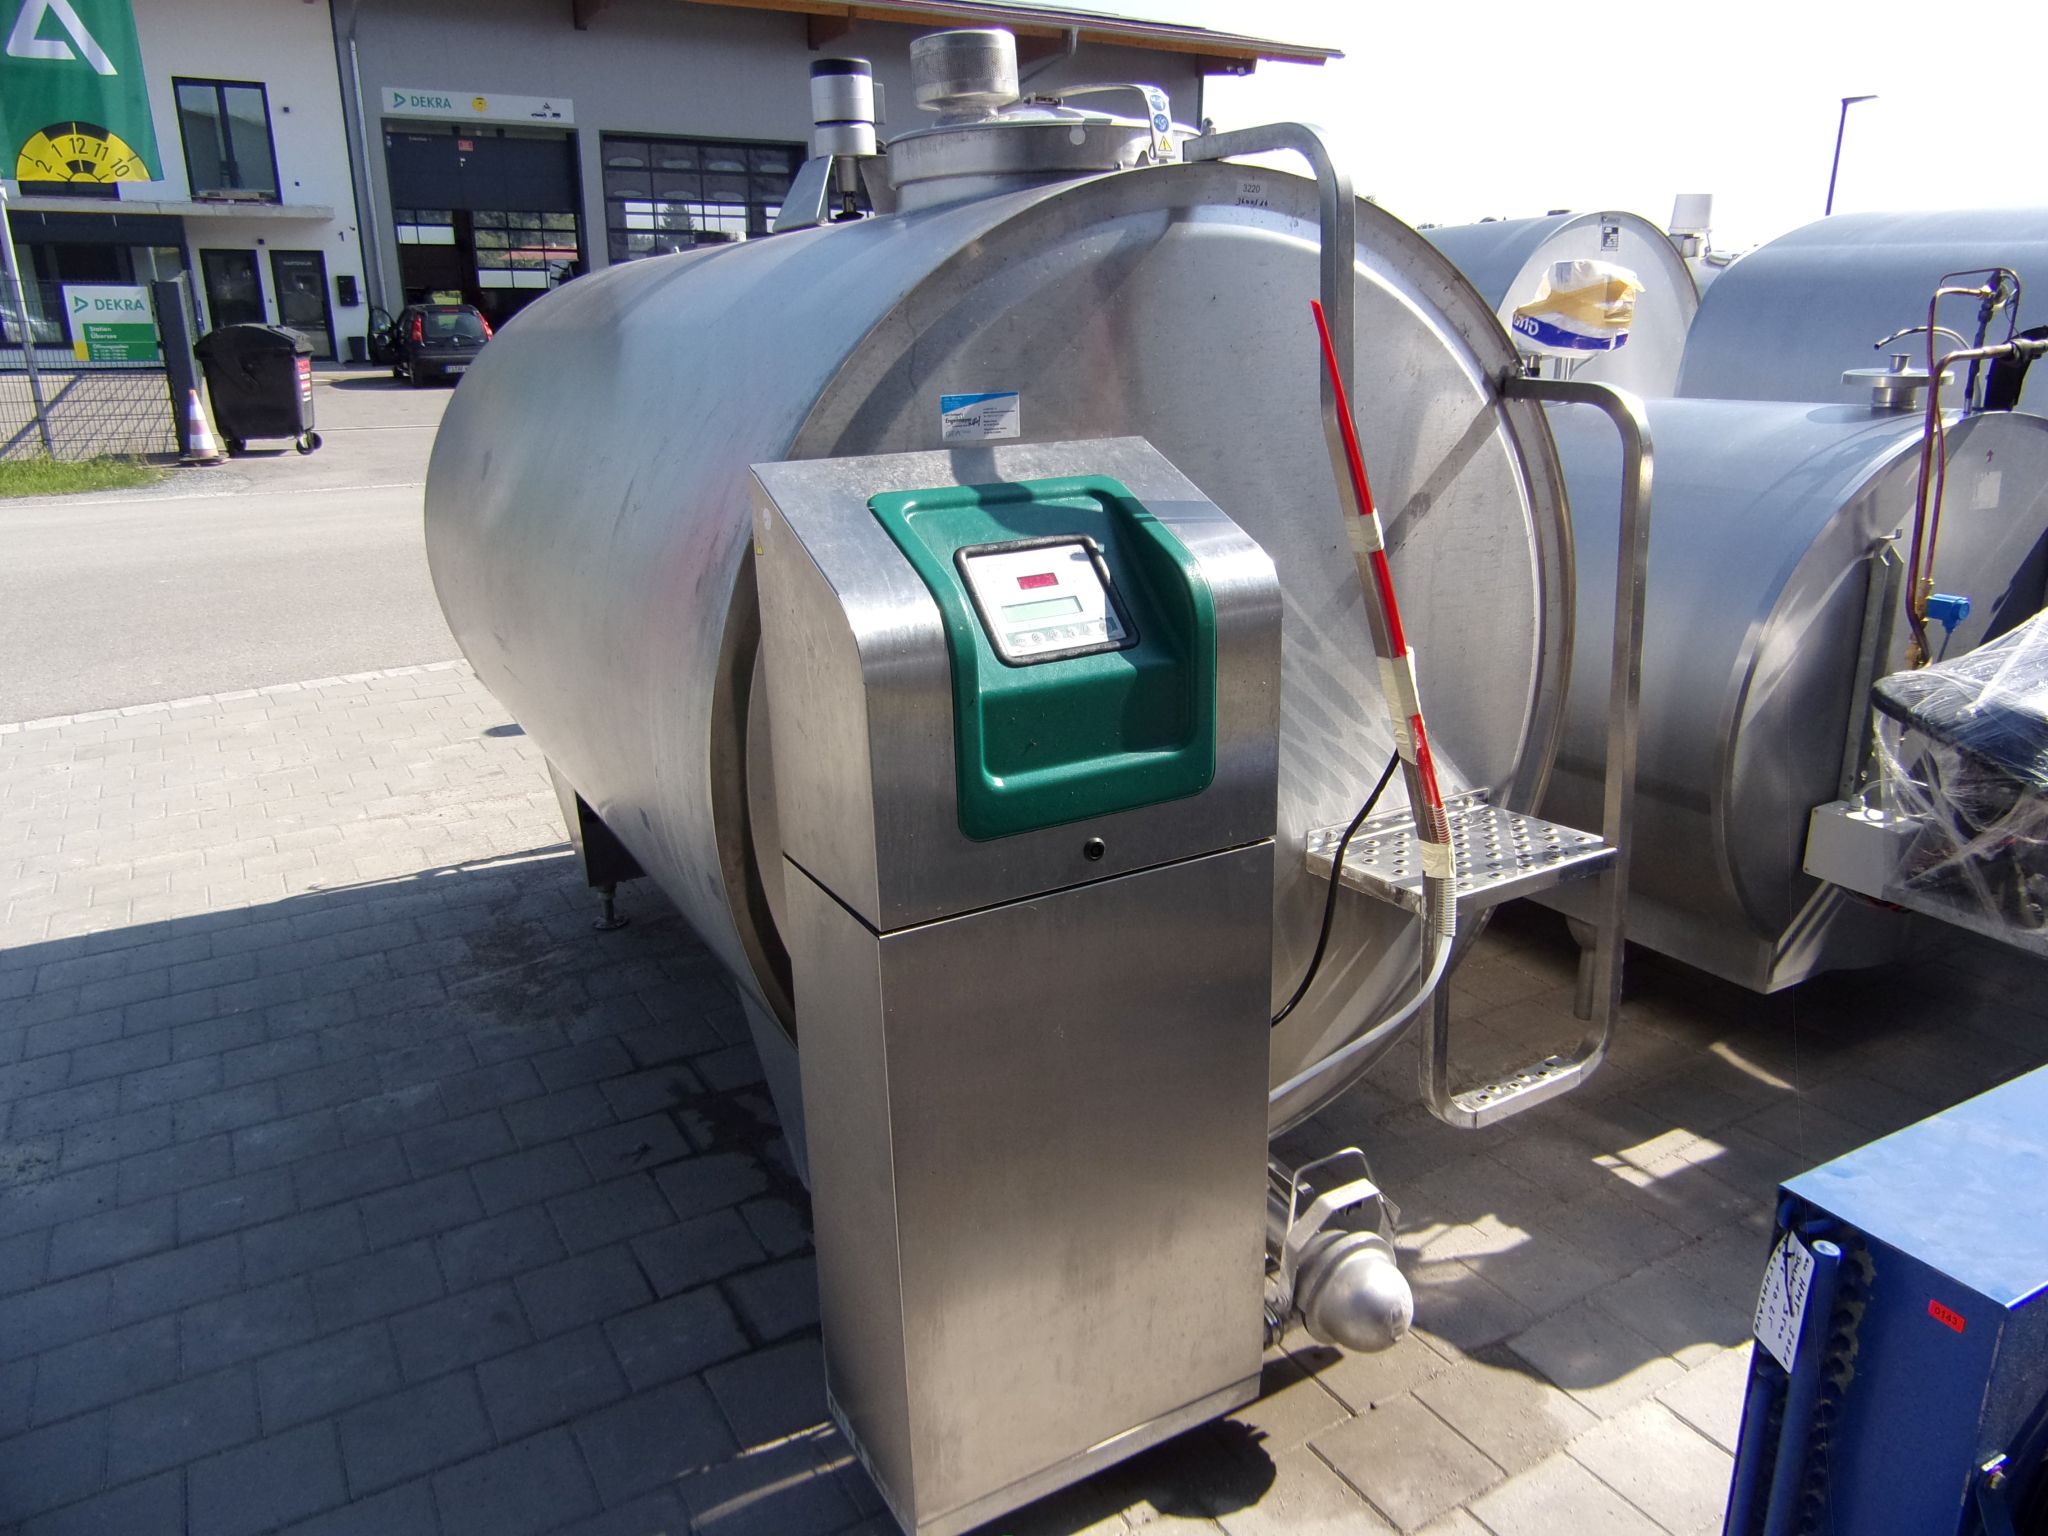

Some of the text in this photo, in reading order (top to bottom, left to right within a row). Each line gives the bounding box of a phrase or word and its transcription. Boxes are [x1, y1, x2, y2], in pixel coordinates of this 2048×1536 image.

[411, 96, 452, 109] DEKRA
[35, 137, 130, 177] 2 1 12 11 10
[1243, 183, 1260, 193] 3220
[338, 231, 344, 242] 1
[94, 299, 145, 311] DEKRA
